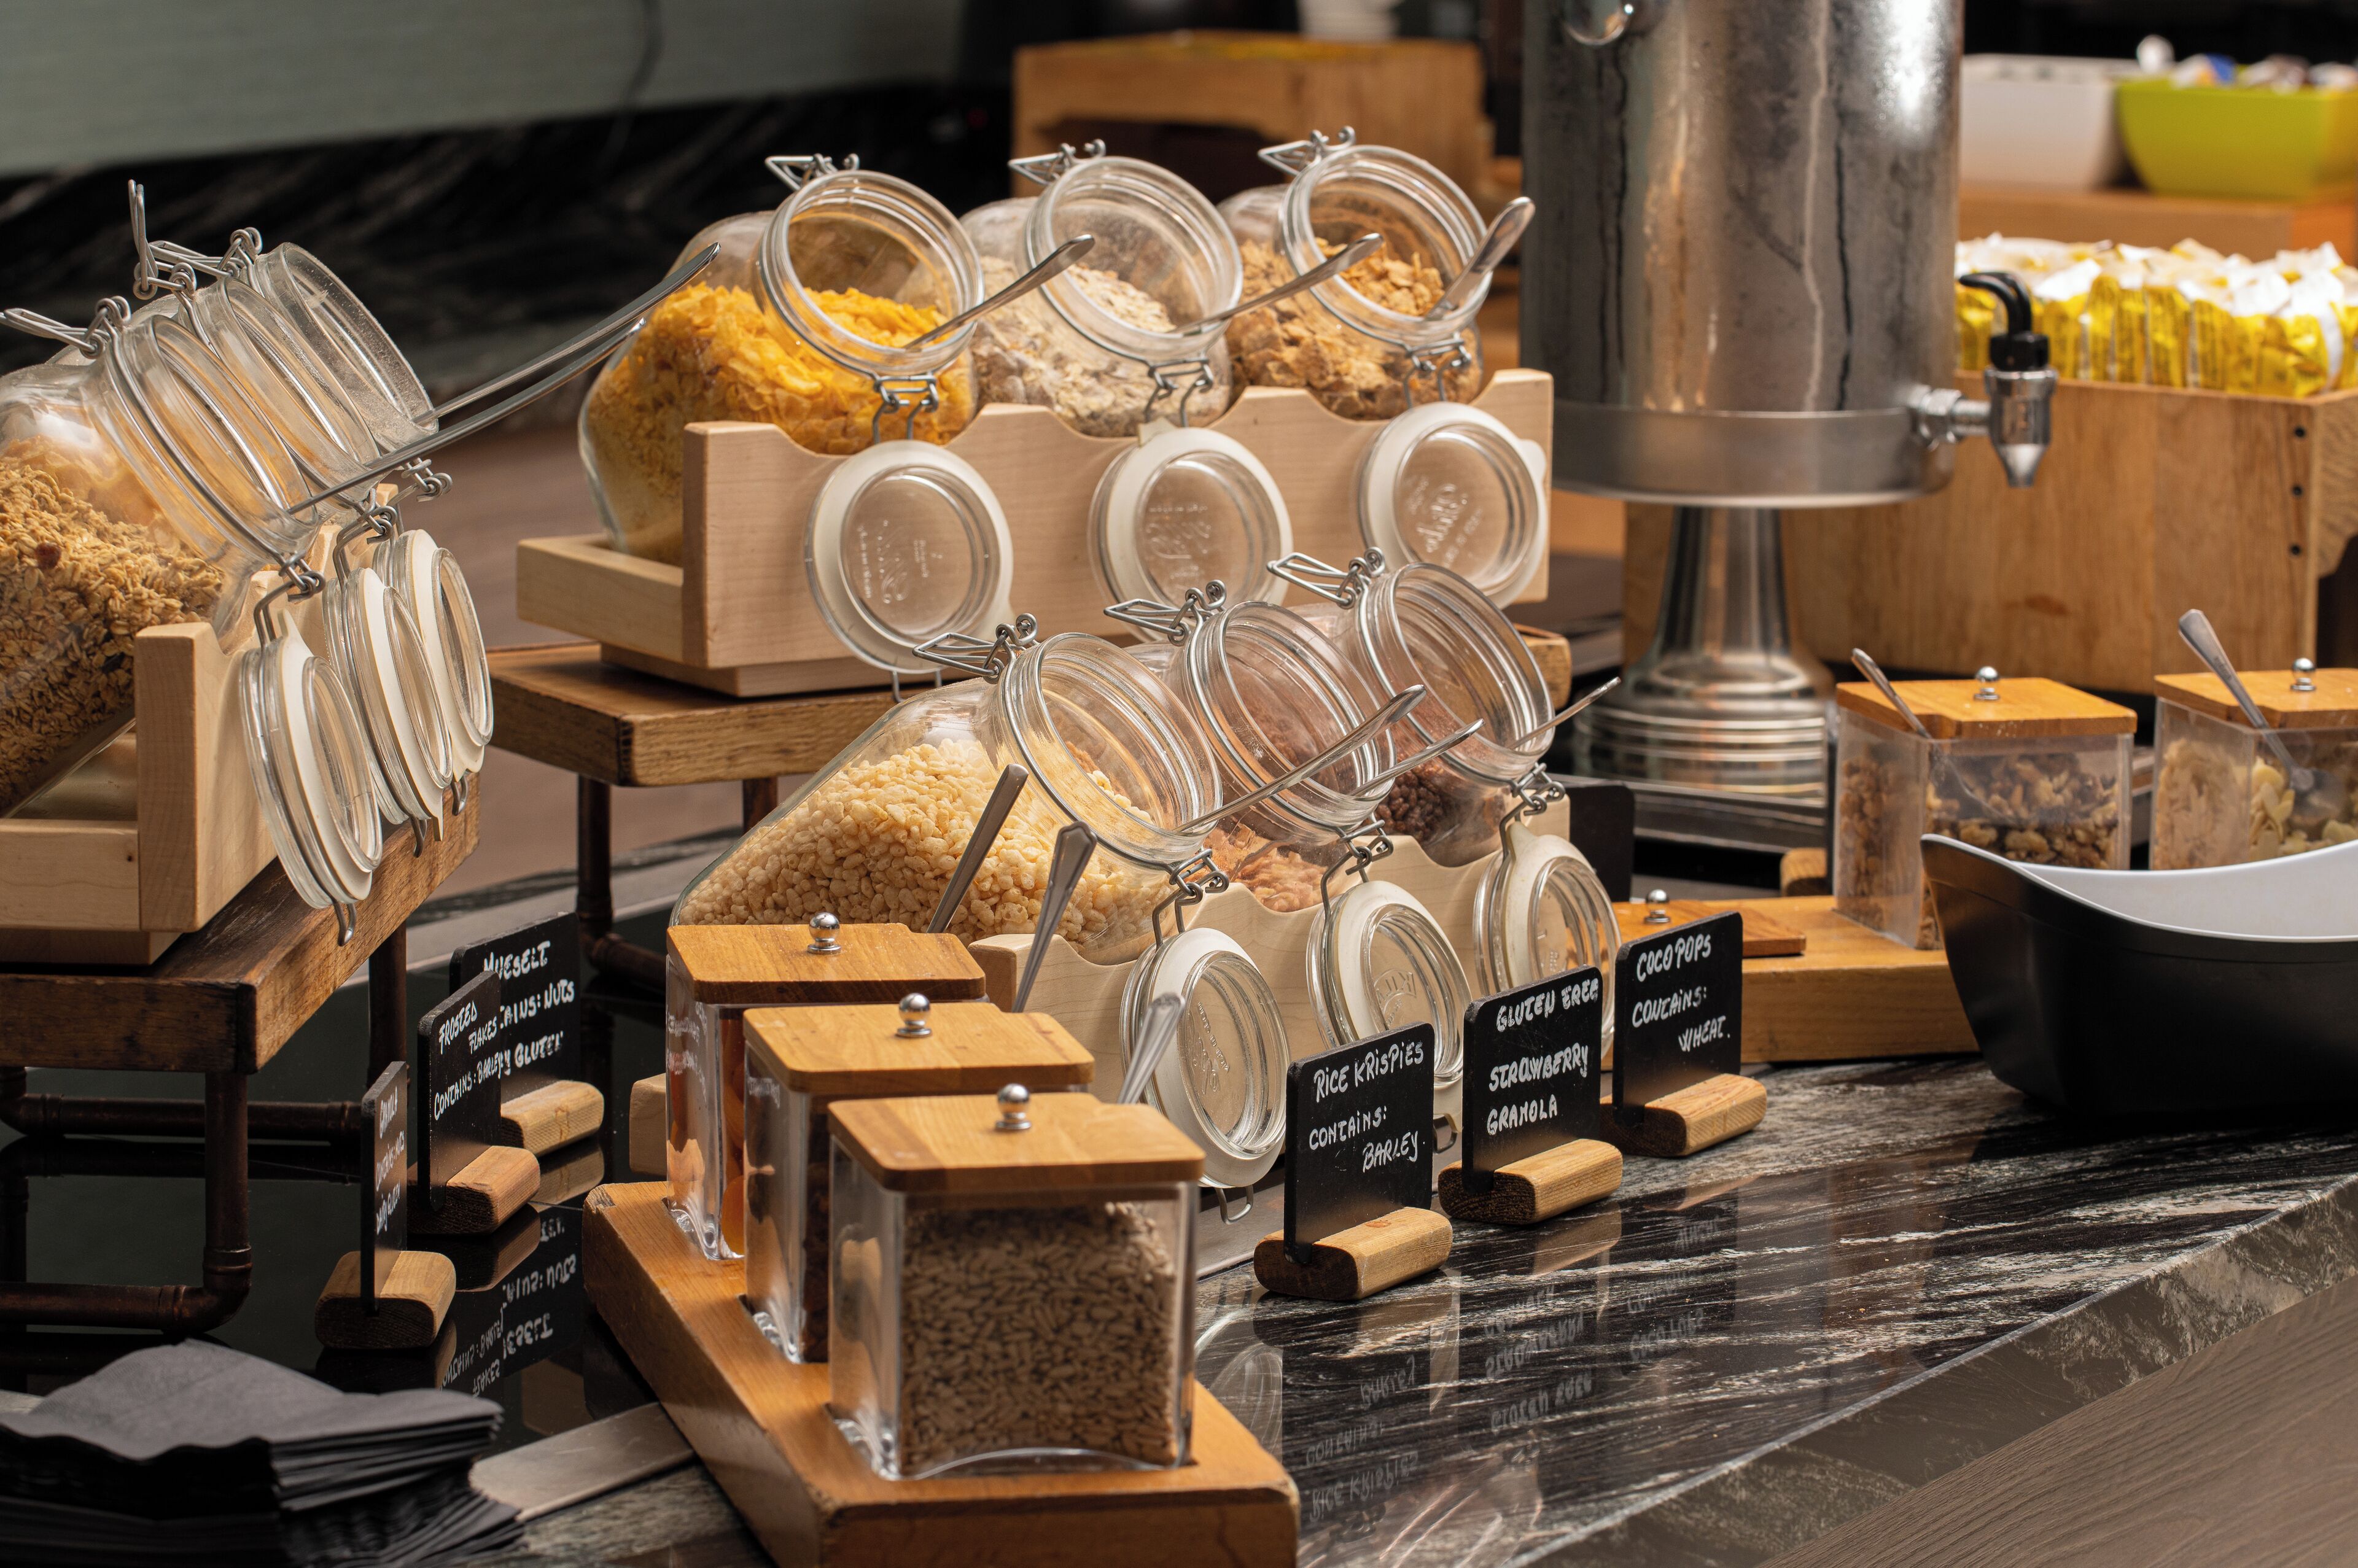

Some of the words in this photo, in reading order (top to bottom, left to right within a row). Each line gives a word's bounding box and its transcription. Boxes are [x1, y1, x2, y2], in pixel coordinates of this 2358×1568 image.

[544, 979, 575, 1009] NUTS
[438, 1000, 478, 1055] FROSTED
[469, 1016, 497, 1054] FLAKES
[1488, 1042, 1588, 1092] STRAWBERRY
[1487, 1094, 1557, 1136] GRANOLA
